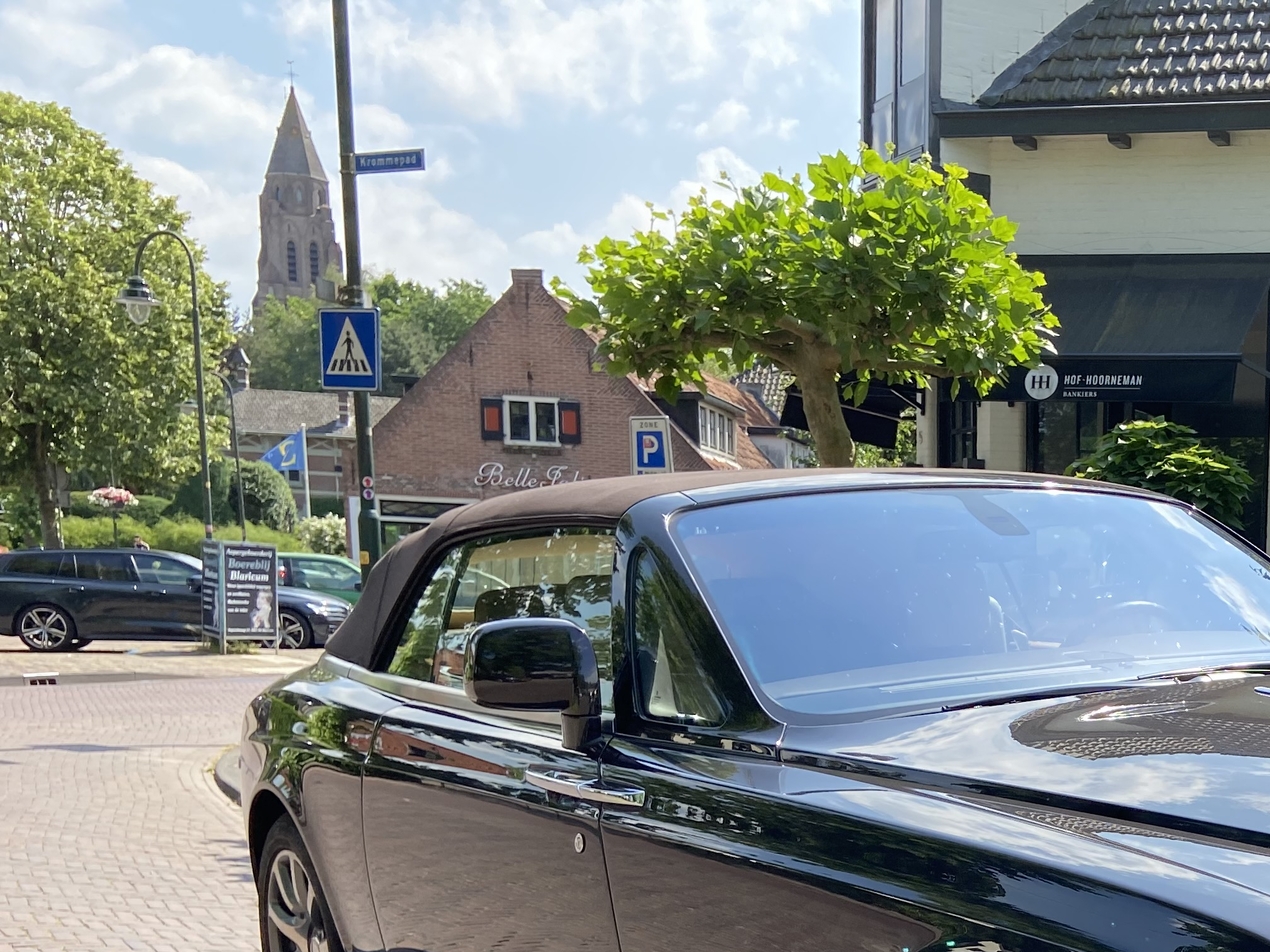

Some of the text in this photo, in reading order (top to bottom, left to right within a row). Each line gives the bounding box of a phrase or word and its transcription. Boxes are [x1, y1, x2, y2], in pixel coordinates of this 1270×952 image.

[360, 154, 416, 167] Krommepad
[639, 421, 659, 429] ZONE
[642, 434, 659, 464] P
[474, 461, 538, 488] Belle
[230, 571, 269, 581] Blaricum
